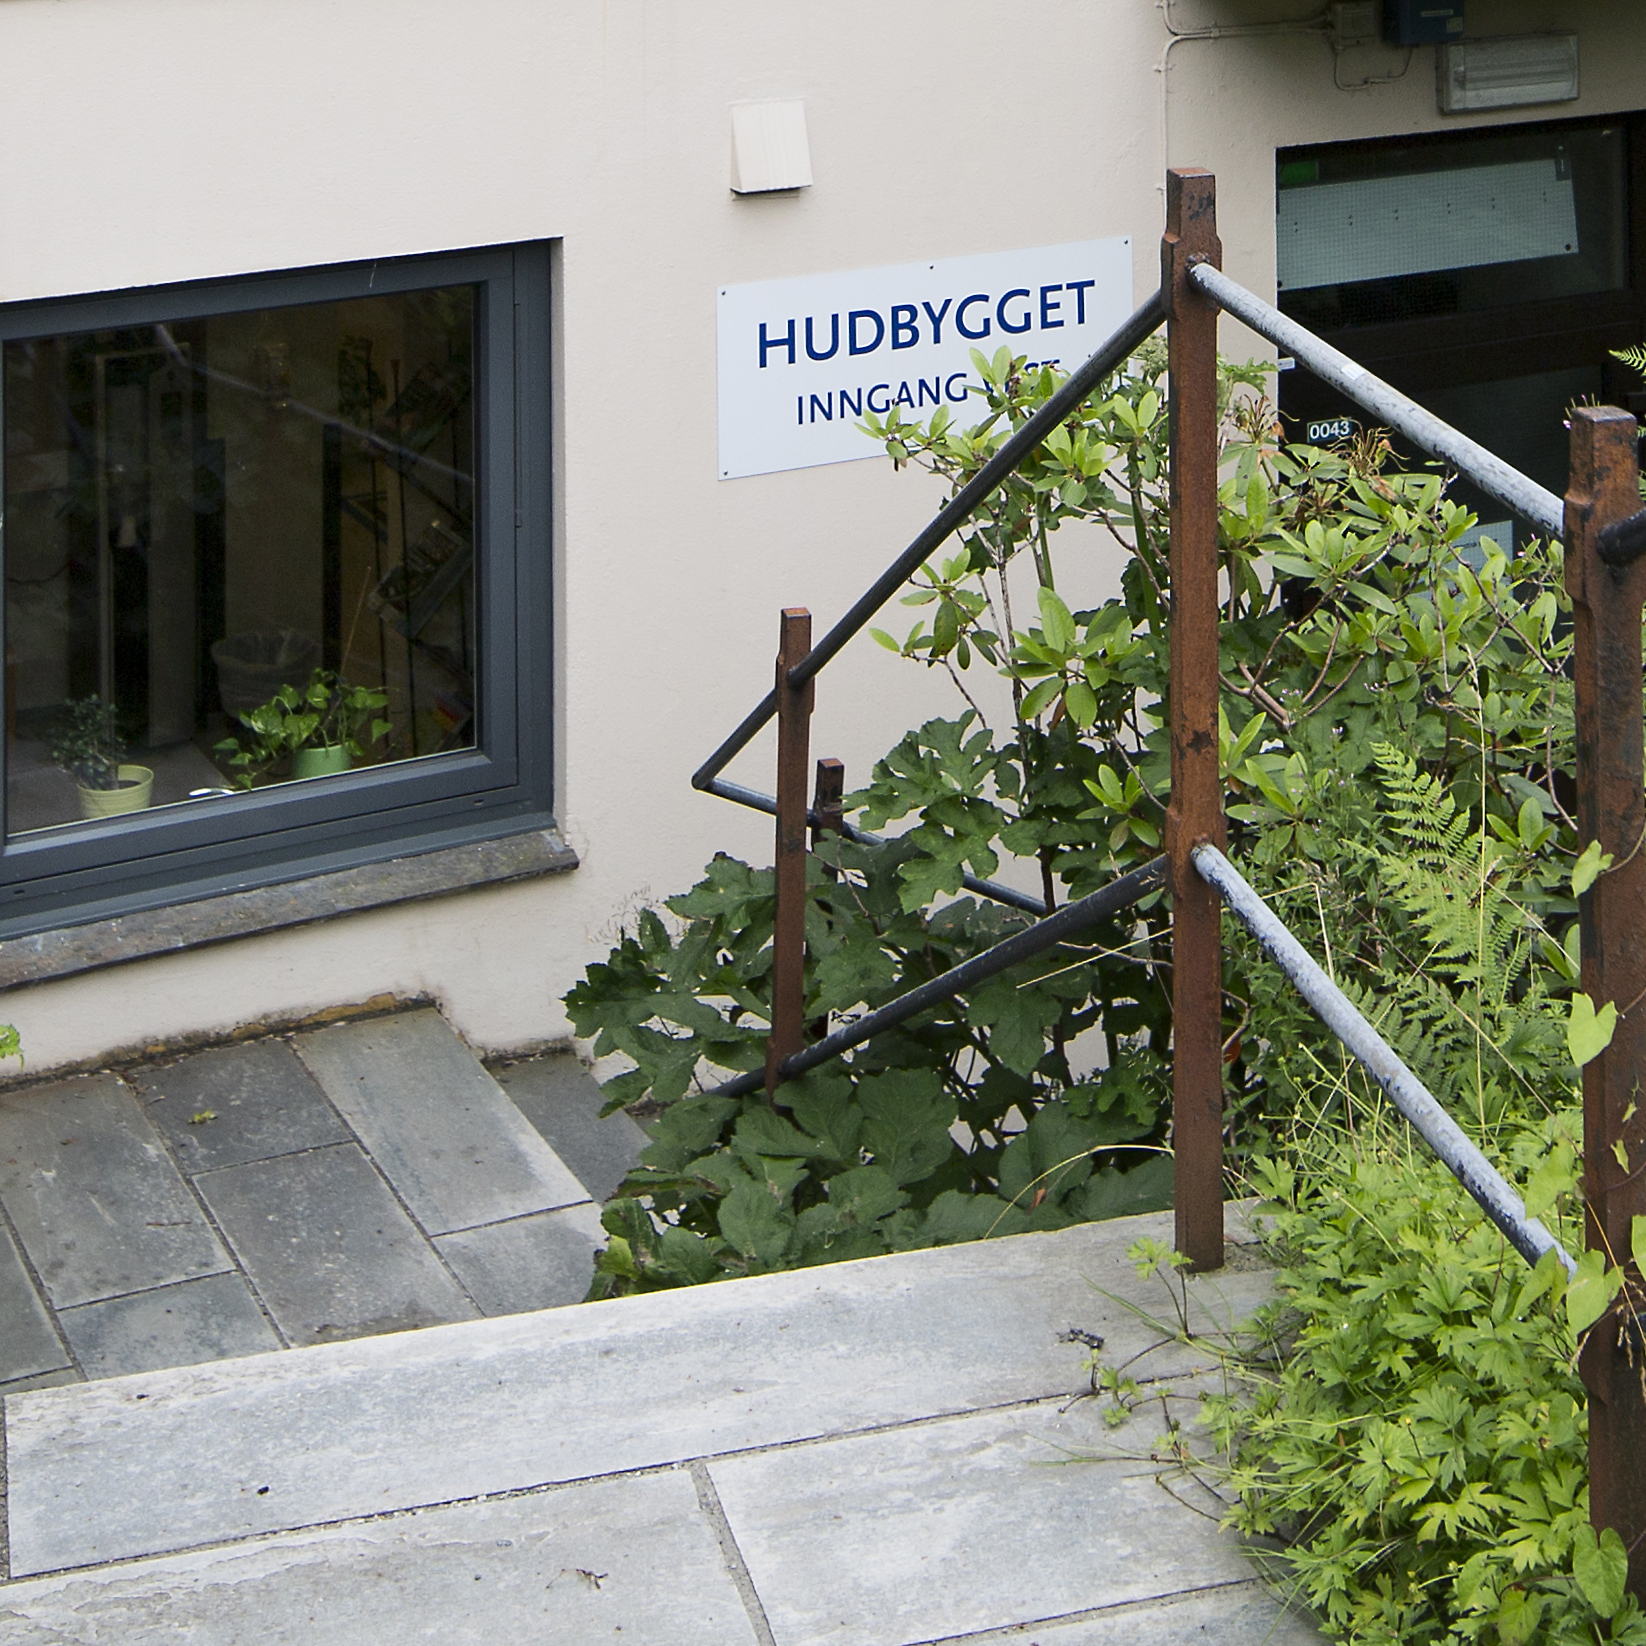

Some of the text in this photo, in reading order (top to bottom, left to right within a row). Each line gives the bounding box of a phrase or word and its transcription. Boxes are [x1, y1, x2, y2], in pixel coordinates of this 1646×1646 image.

[758, 279, 1096, 368] HUDBYGGET
[797, 372, 968, 425] INNGANG
[1309, 420, 1350, 440] 0043
